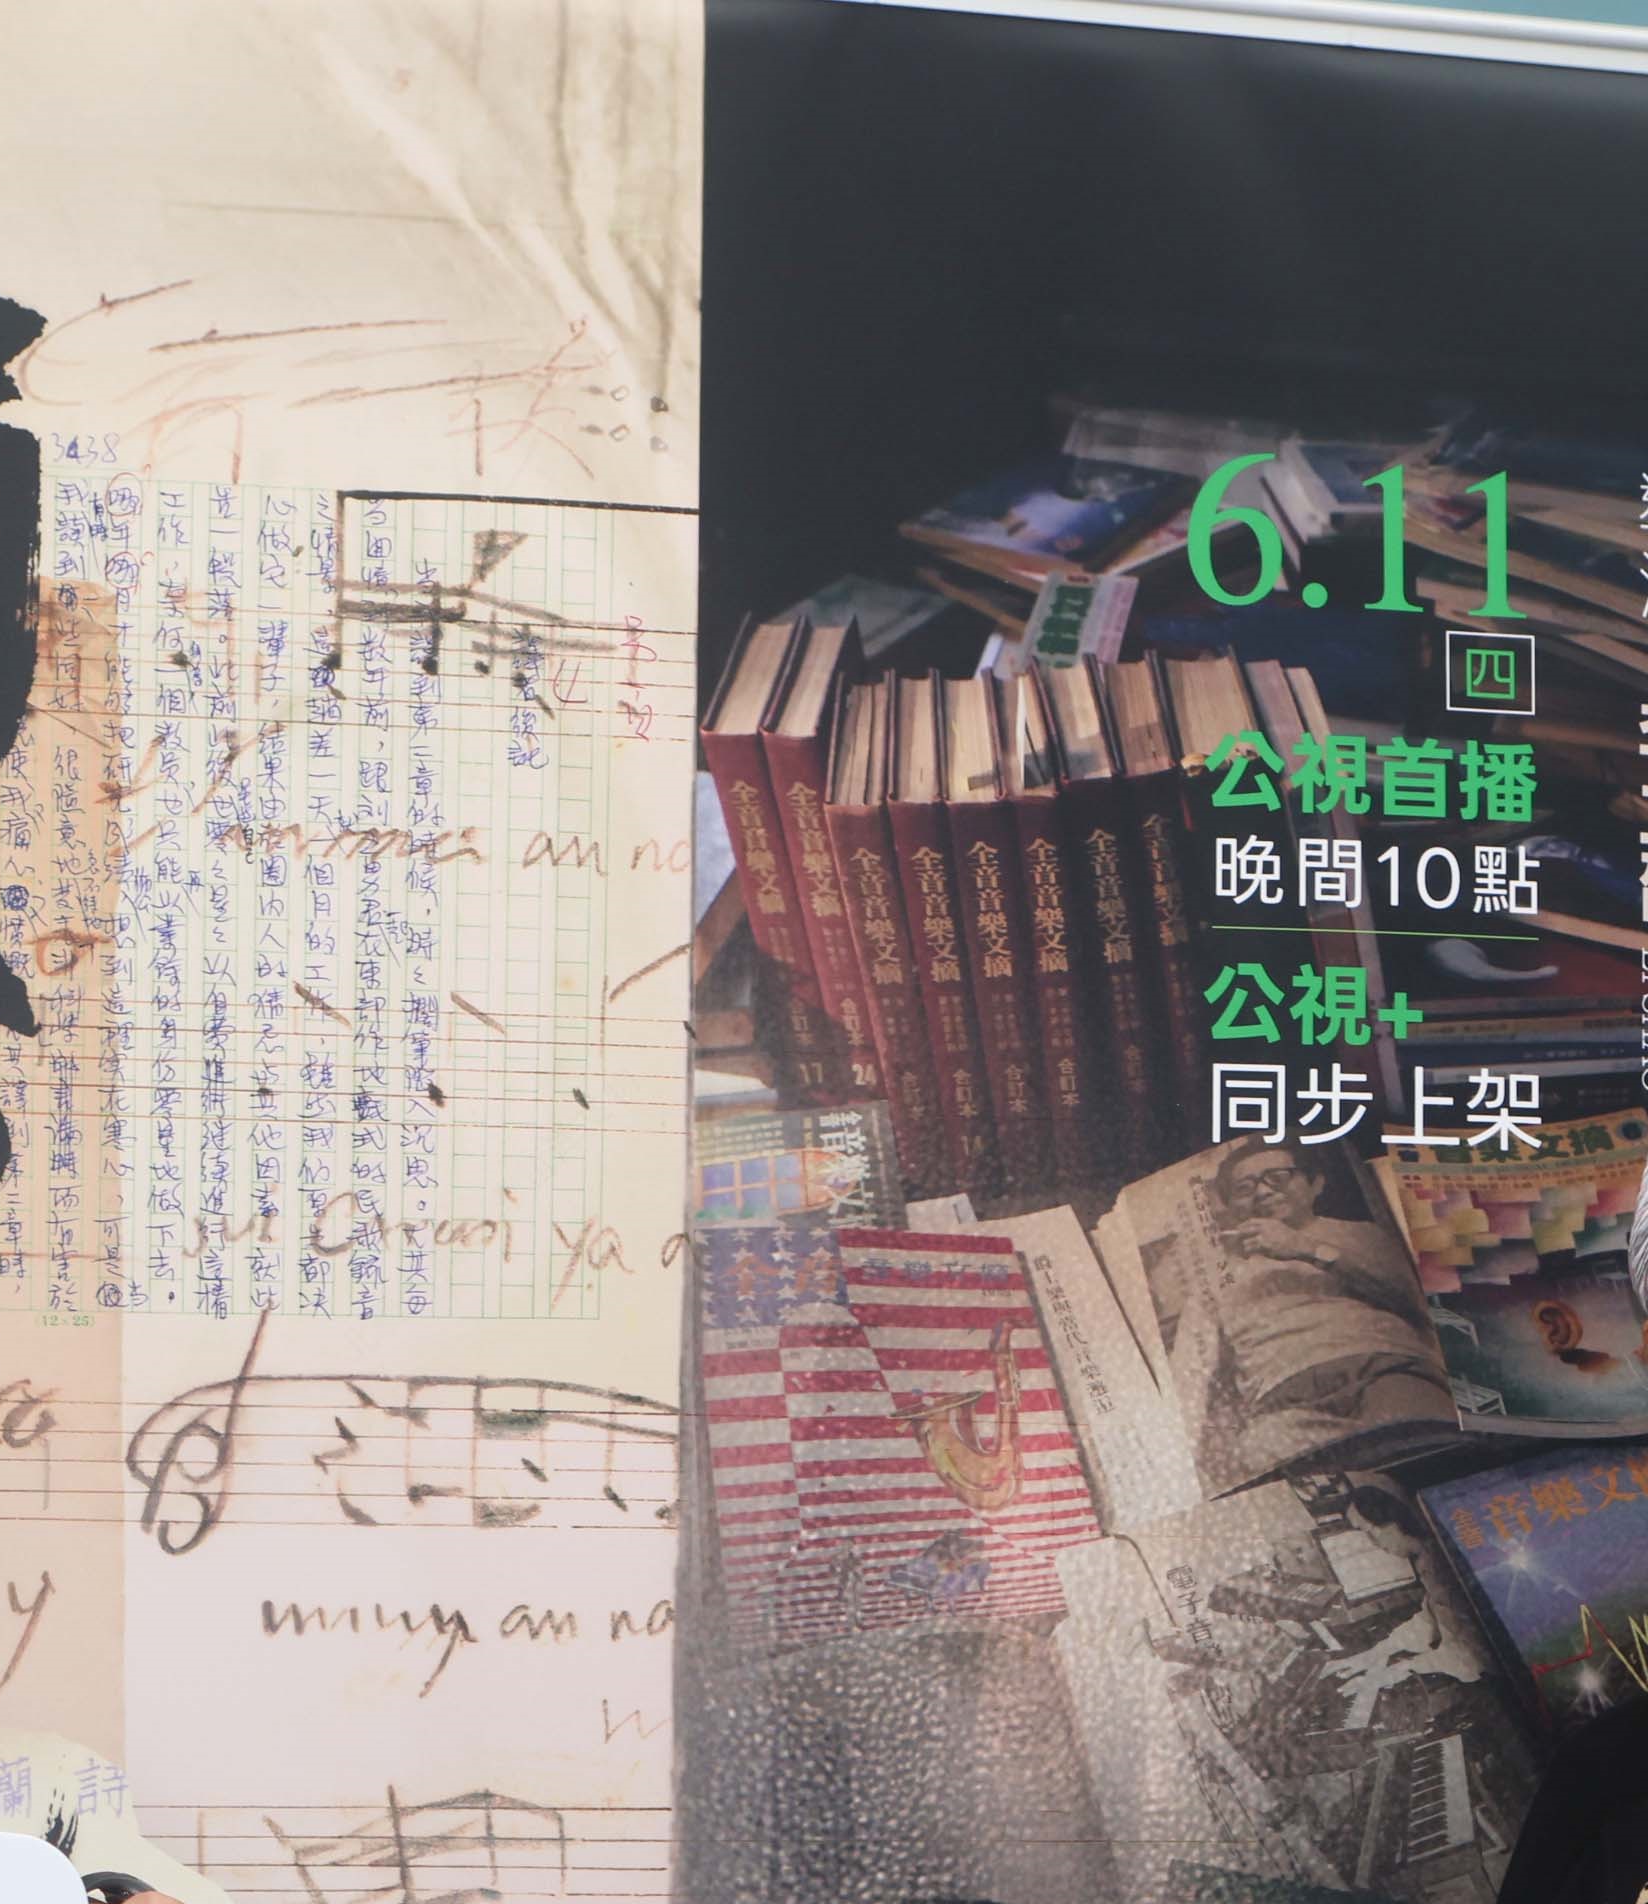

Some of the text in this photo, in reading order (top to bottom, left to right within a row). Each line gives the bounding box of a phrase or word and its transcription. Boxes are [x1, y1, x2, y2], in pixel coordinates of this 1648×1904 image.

[1187, 452, 1528, 619] 6.11
[1465, 648, 1516, 701] 四
[1205, 730, 1539, 823] 公視首播
[849, 847, 905, 986] 全音音樂文摘
[910, 845, 961, 984] 全音音樂文摘
[967, 840, 1014, 980] 全音音樂文摘
[1025, 837, 1070, 974] 全音音樂文摘
[1084, 828, 1133, 965] 全音音樂文摘
[1214, 834, 1540, 916] 晚間10點
[1203, 961, 1425, 1046] 公視+
[1211, 1063, 1543, 1152] 同步上架
